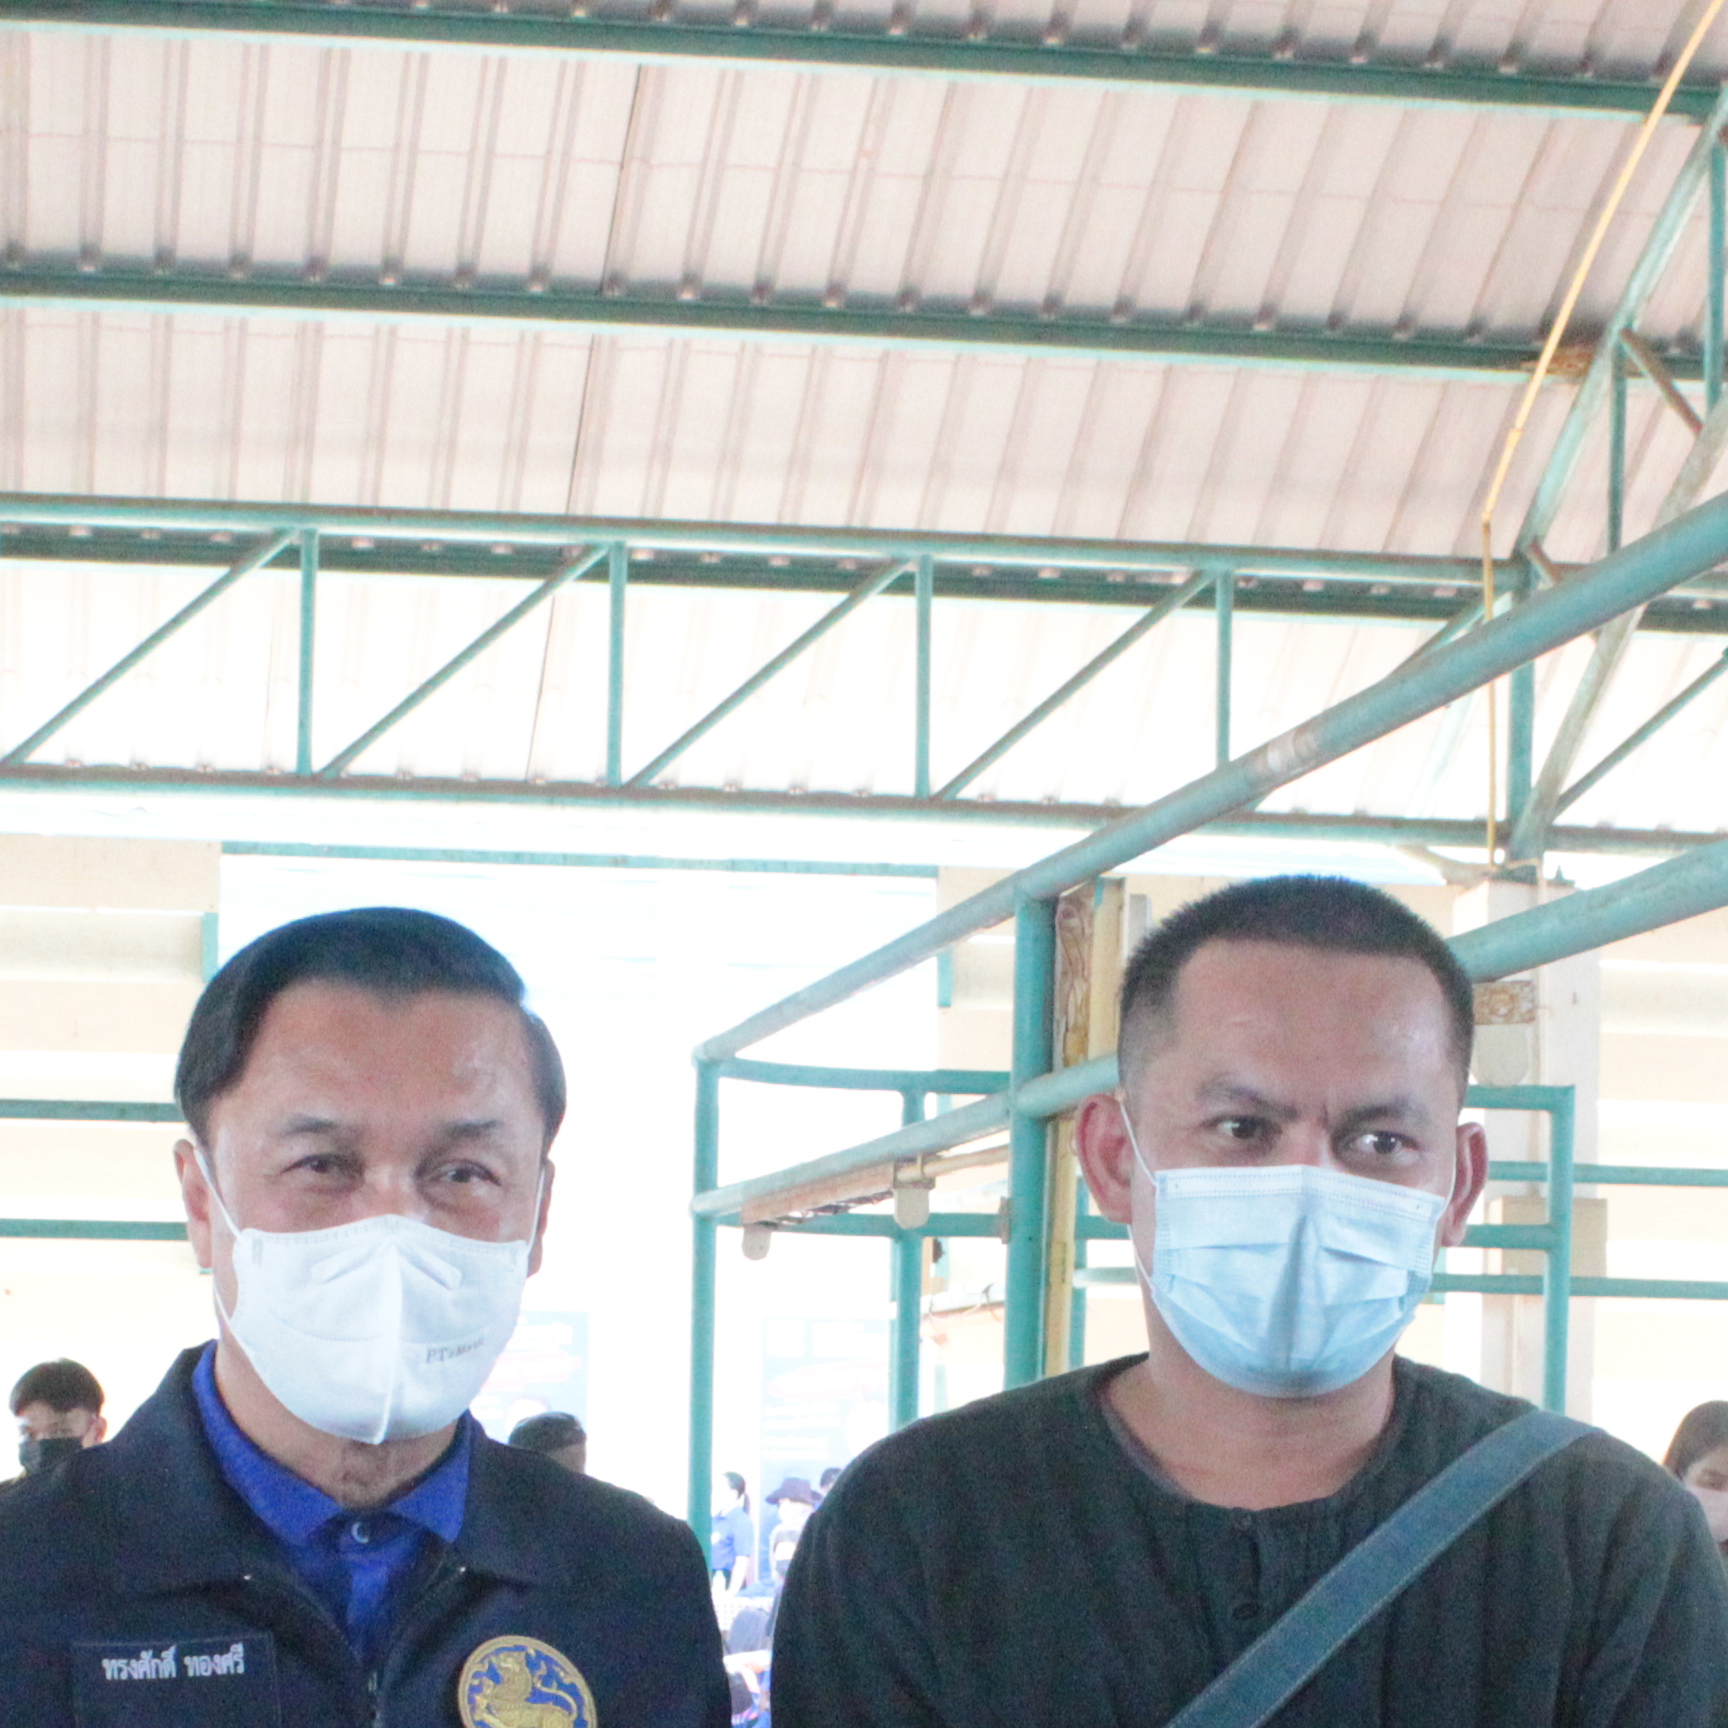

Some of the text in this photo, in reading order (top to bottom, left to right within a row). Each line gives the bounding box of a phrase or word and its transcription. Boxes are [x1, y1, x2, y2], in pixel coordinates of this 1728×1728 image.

[101, 1642, 245, 1680] ทรงศักดิ์ ทองศรี
